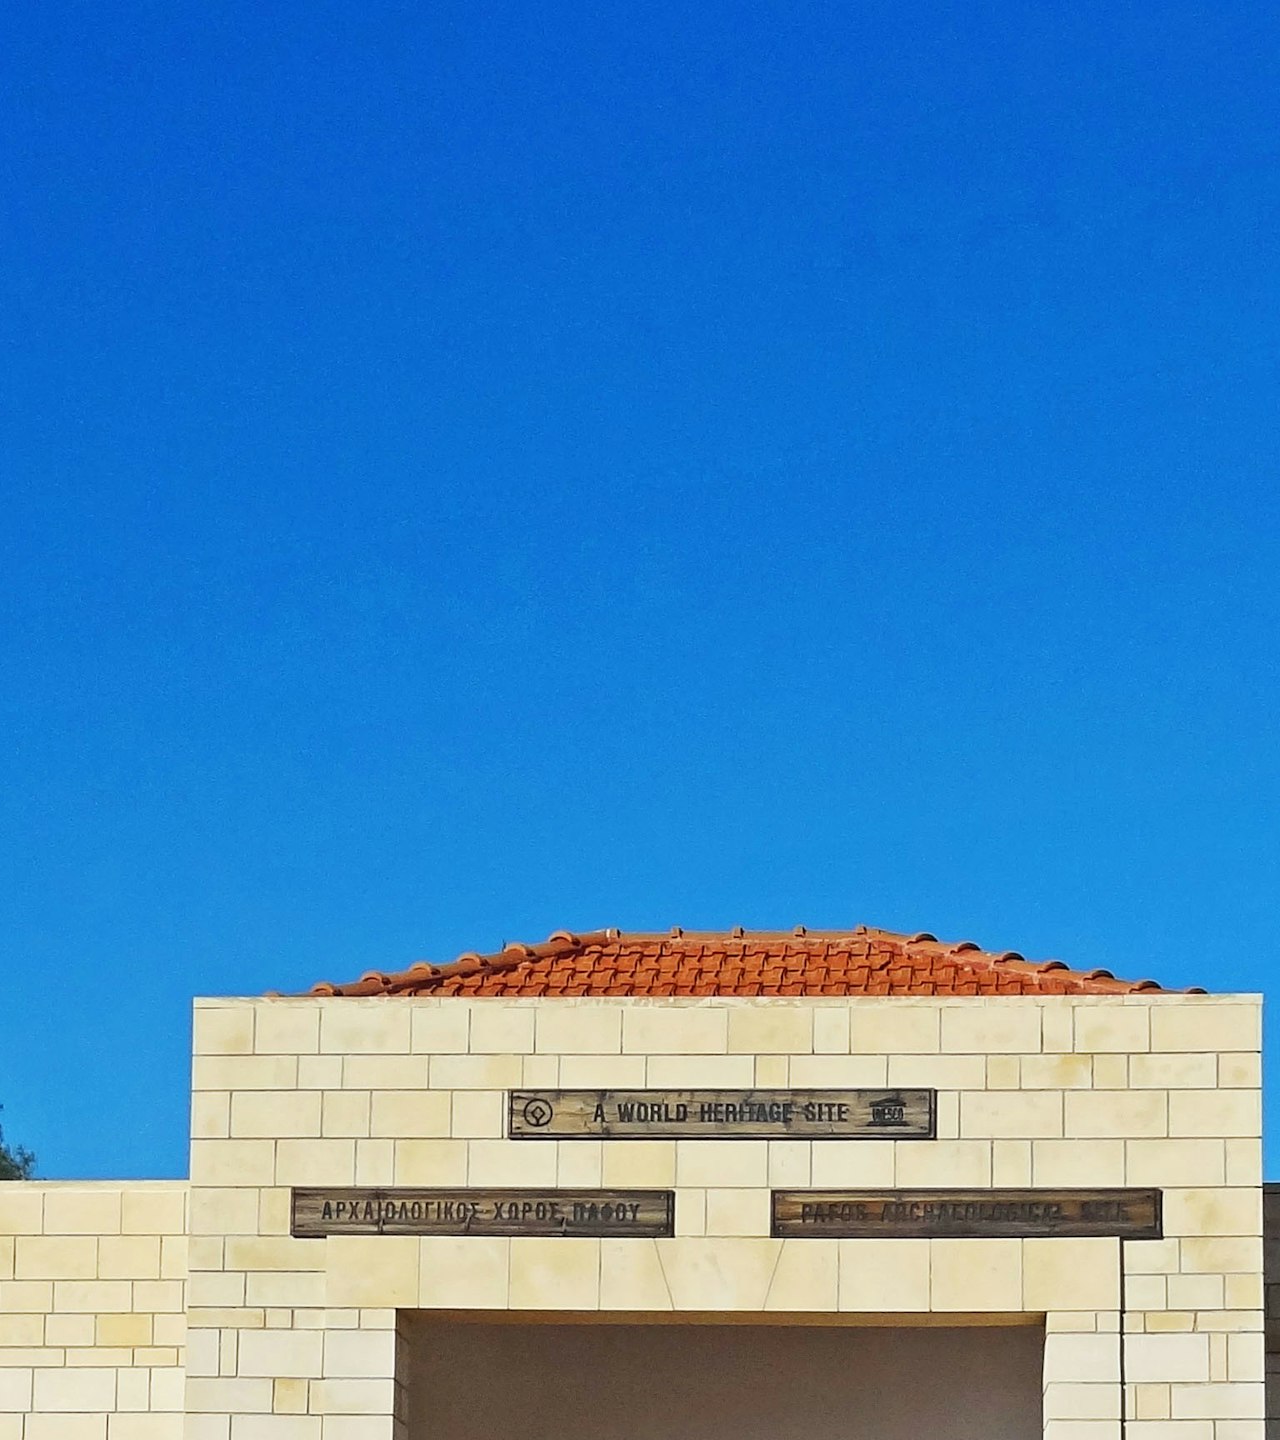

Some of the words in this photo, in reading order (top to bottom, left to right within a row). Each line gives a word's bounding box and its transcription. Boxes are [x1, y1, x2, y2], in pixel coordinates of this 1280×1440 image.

[593, 1103, 607, 1122] A
[617, 1102, 688, 1122] WORLD
[700, 1103, 793, 1122] HERITAGE
[804, 1102, 850, 1122] SITE
[321, 1201, 480, 1220] ΑΡΧΑΙΟΛΟΓΙΚΟΣ
[493, 1202, 559, 1221] ΧΩΡΟΣ
[572, 1202, 640, 1222] ΠΑΦΟΥ
